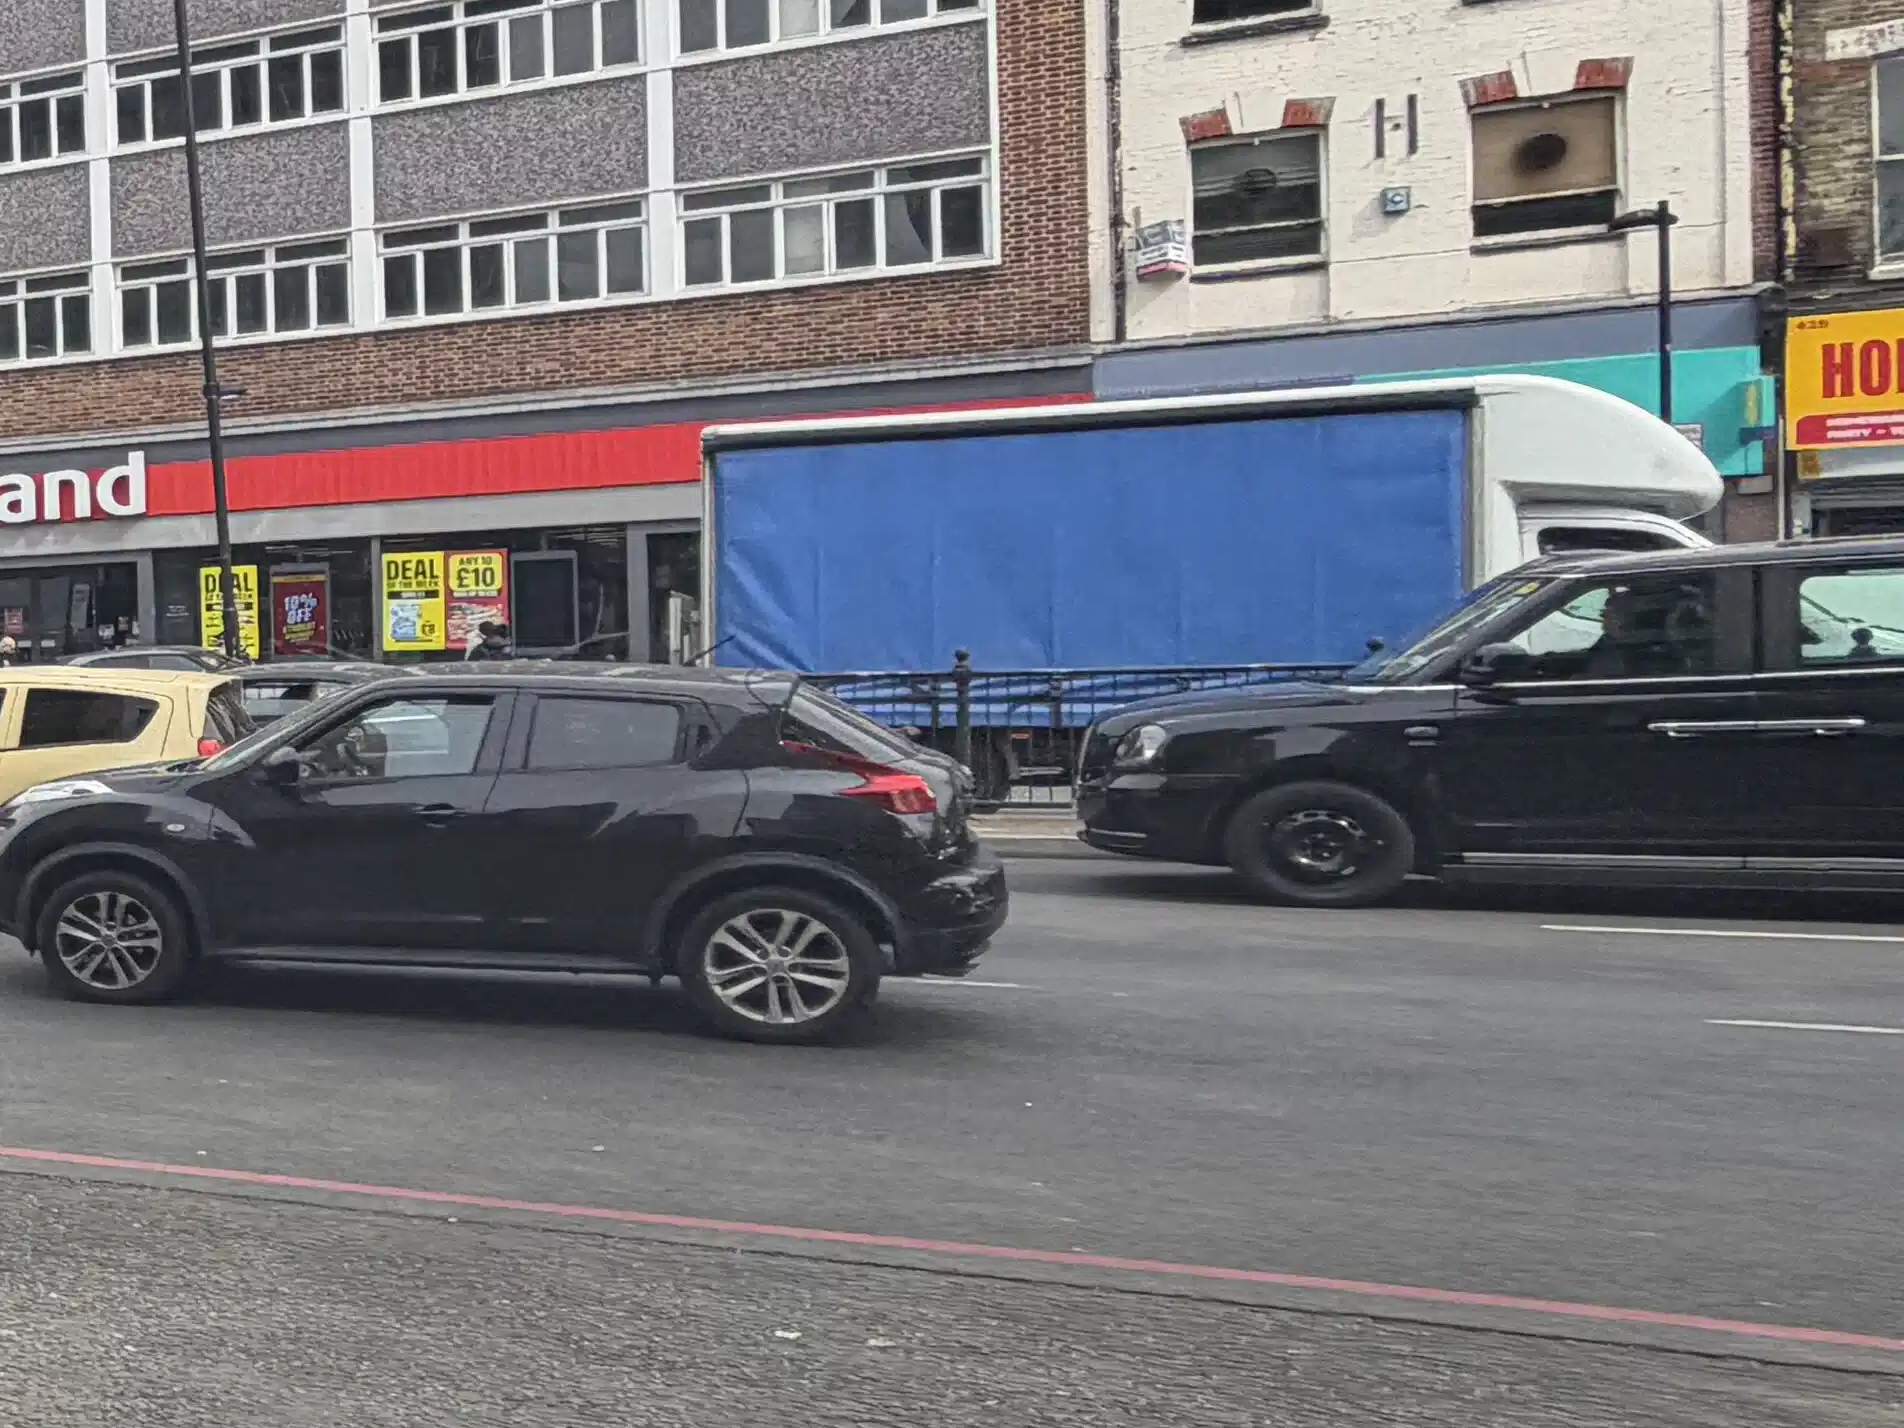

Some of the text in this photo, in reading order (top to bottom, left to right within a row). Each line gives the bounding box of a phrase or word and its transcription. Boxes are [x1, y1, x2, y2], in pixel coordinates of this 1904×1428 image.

[386, 558, 441, 582] DEAL
[456, 566, 496, 589] £10
[204, 572, 254, 593] DAL
